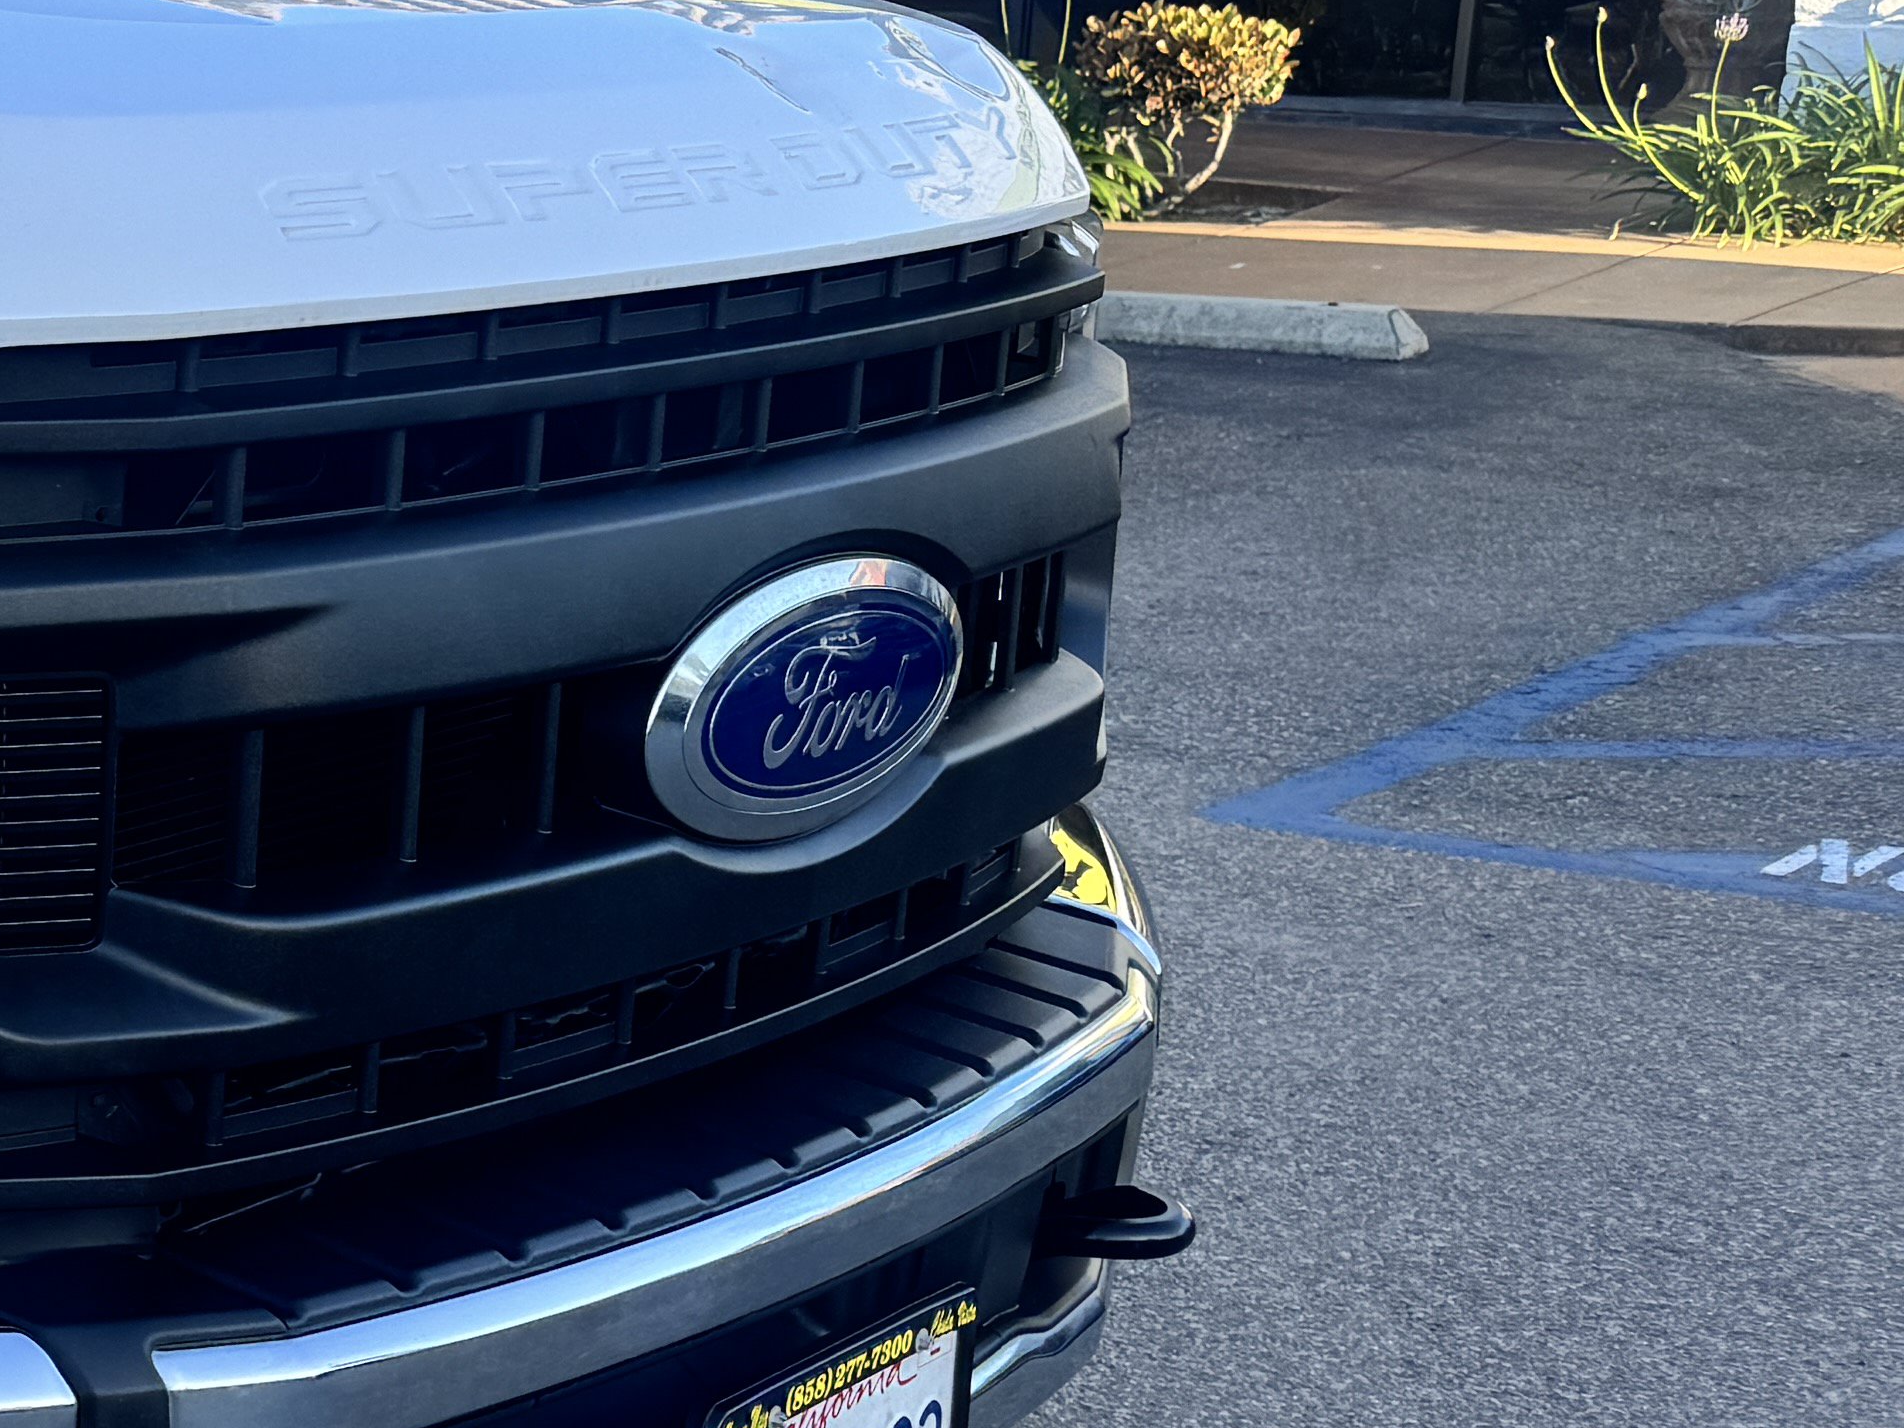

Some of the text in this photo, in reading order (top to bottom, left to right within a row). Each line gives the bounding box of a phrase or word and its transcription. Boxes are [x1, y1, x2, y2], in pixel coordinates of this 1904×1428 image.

[259, 141, 780, 244] SUPER
[763, 636, 914, 770] Ford
[785, 1366, 834, 1417] (858)
[834, 1329, 914, 1389] 277-7300
